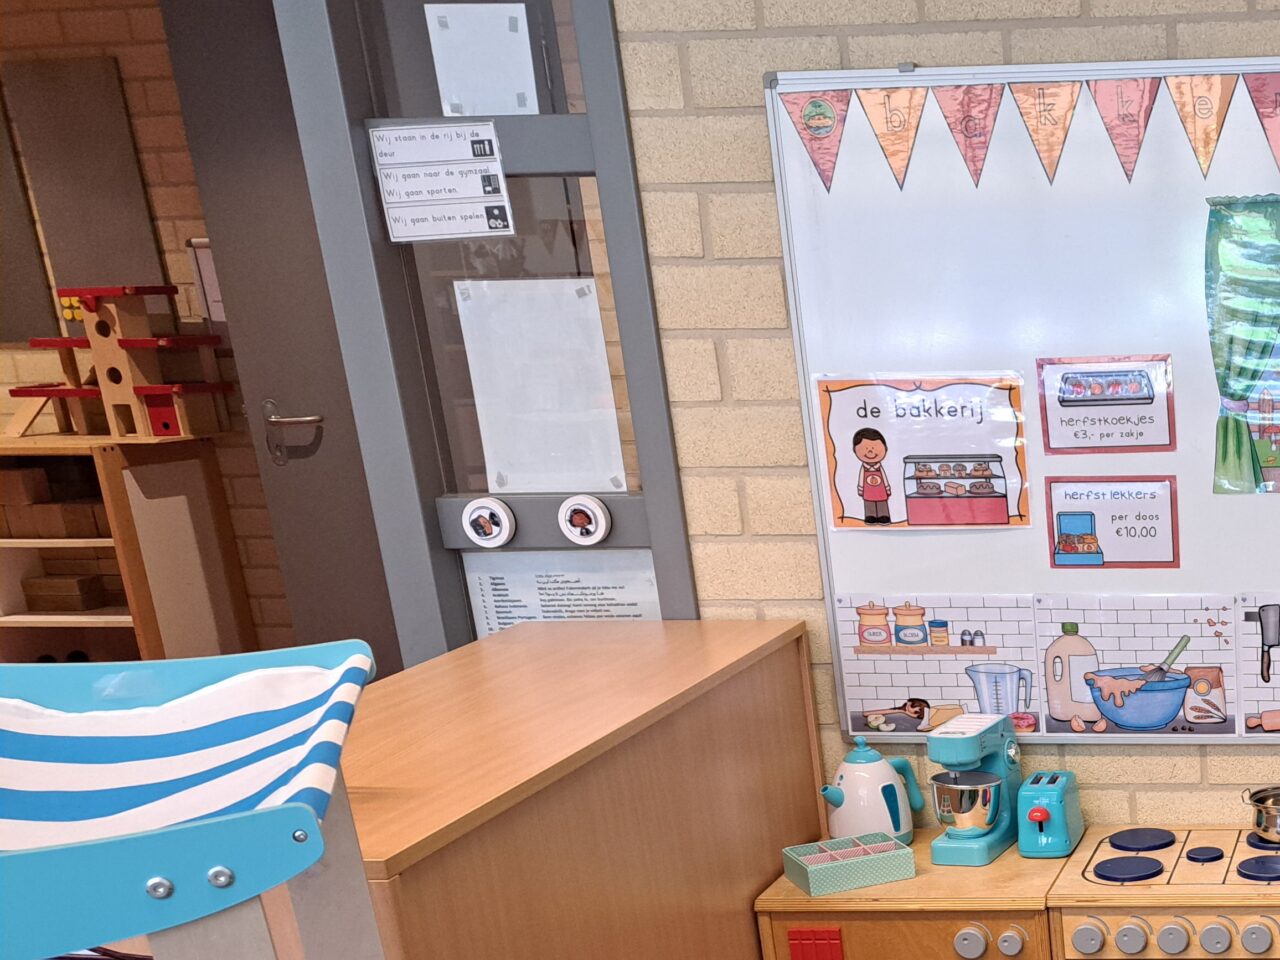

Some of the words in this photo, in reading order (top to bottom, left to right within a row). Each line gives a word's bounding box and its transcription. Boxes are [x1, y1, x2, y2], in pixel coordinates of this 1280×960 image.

[375, 133, 392, 145] Wij
[394, 133, 417, 142] staan
[419, 132, 427, 141] in
[430, 131, 440, 140] de
[443, 131, 454, 142] rij
[456, 130, 467, 140] bij
[469, 129, 480, 138] de
[382, 170, 399, 182] Wij
[401, 171, 421, 181] gaan
[423, 170, 441, 178] naar
[444, 168, 455, 177] de
[386, 188, 402, 199] Wij
[404, 188, 424, 198] gaan
[391, 213, 408, 225] Wij
[410, 214, 429, 225] gaan
[432, 212, 457, 222] buiten
[856, 398, 881, 419] de
[894, 398, 984, 425] bakkerij
[1060, 414, 1155, 427] herfstkoekjes
[1099, 431, 1114, 441] per
[1120, 429, 1144, 440] zakje
[1111, 513, 1128, 525] per
[1135, 511, 1160, 521] doos
